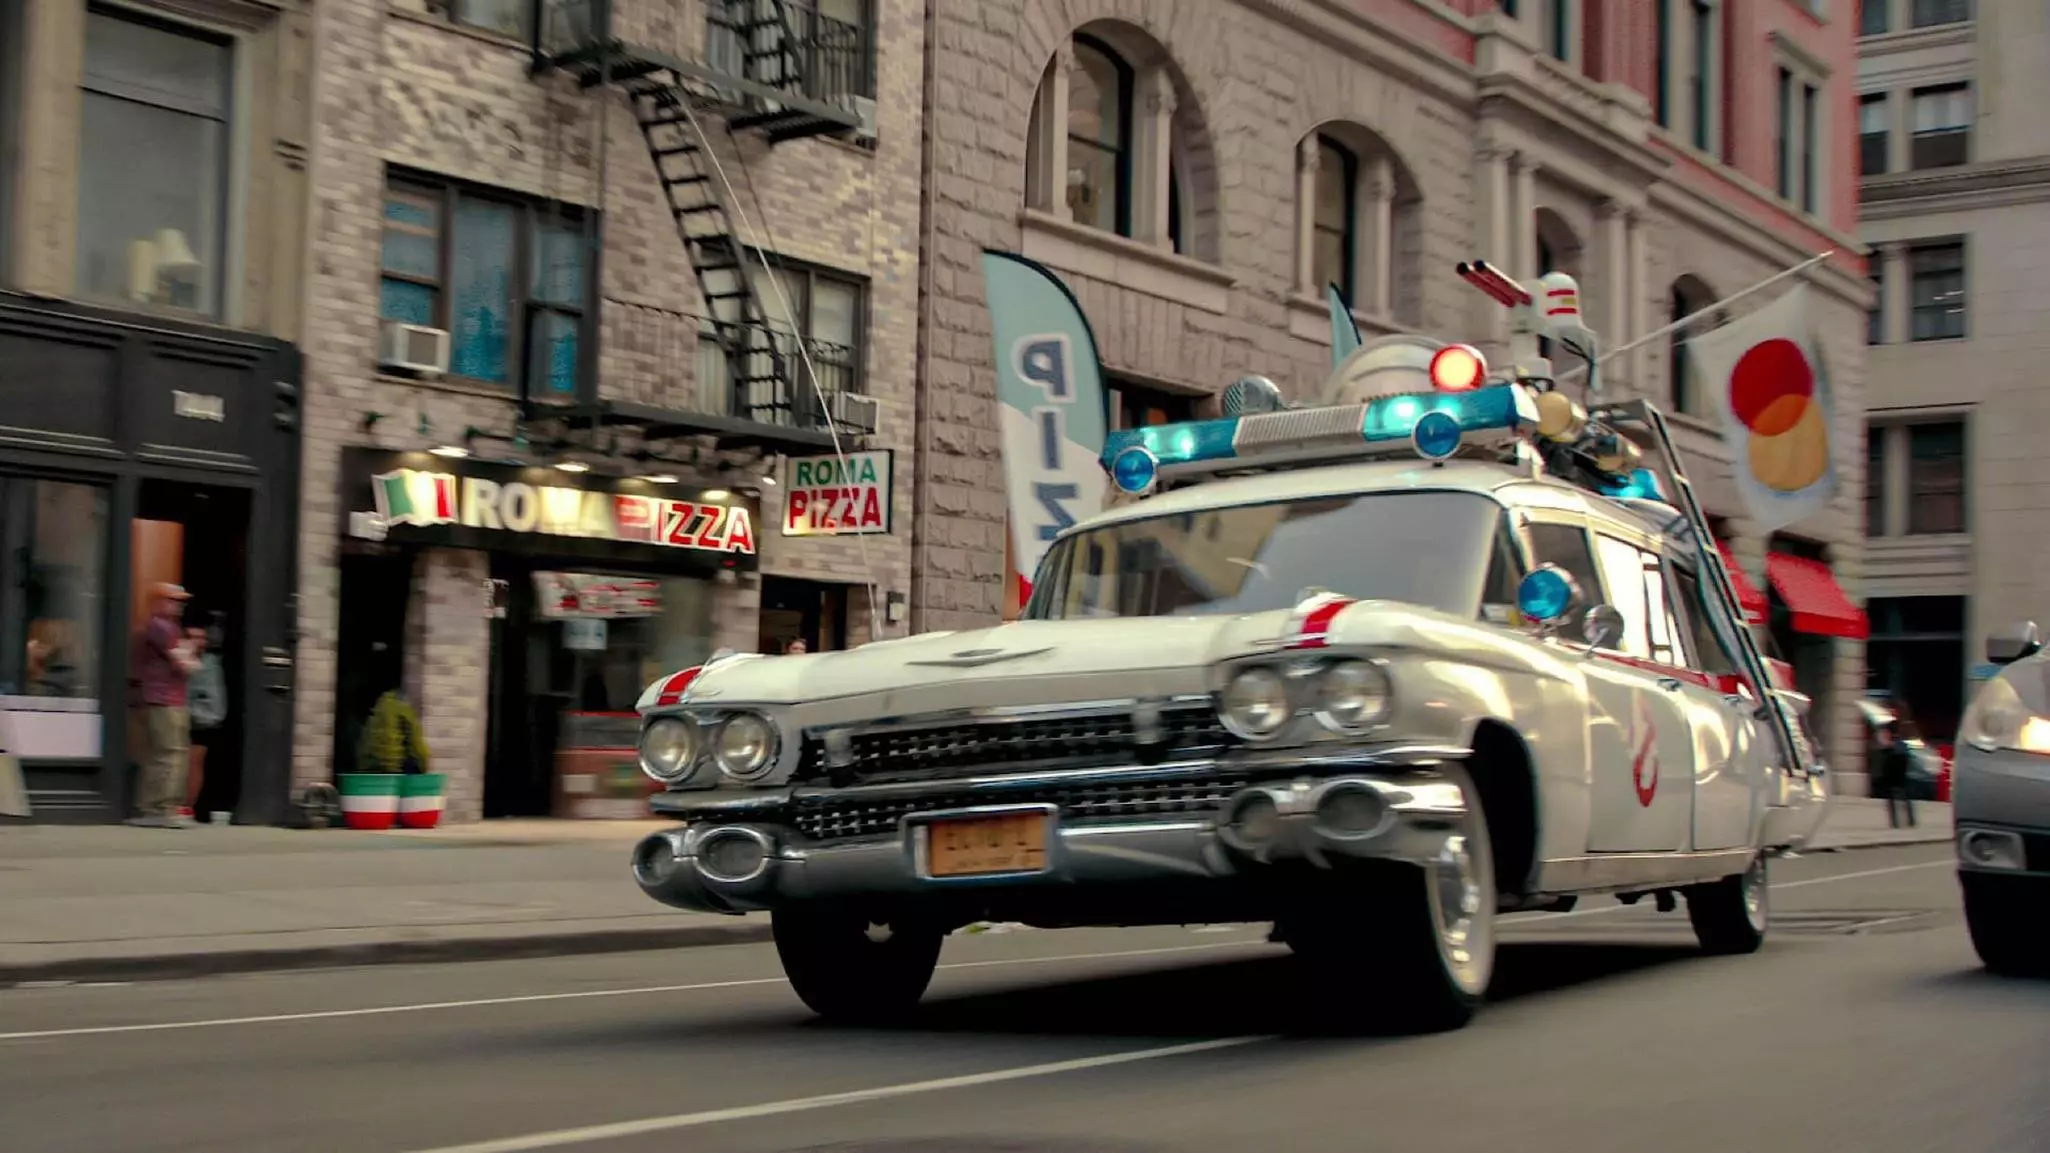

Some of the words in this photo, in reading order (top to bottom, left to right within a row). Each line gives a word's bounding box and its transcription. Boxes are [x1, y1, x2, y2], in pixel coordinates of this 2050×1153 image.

[797, 457, 877, 486] ROMA
[614, 494, 756, 555] PIZZA
[789, 487, 882, 529] PIZZA
